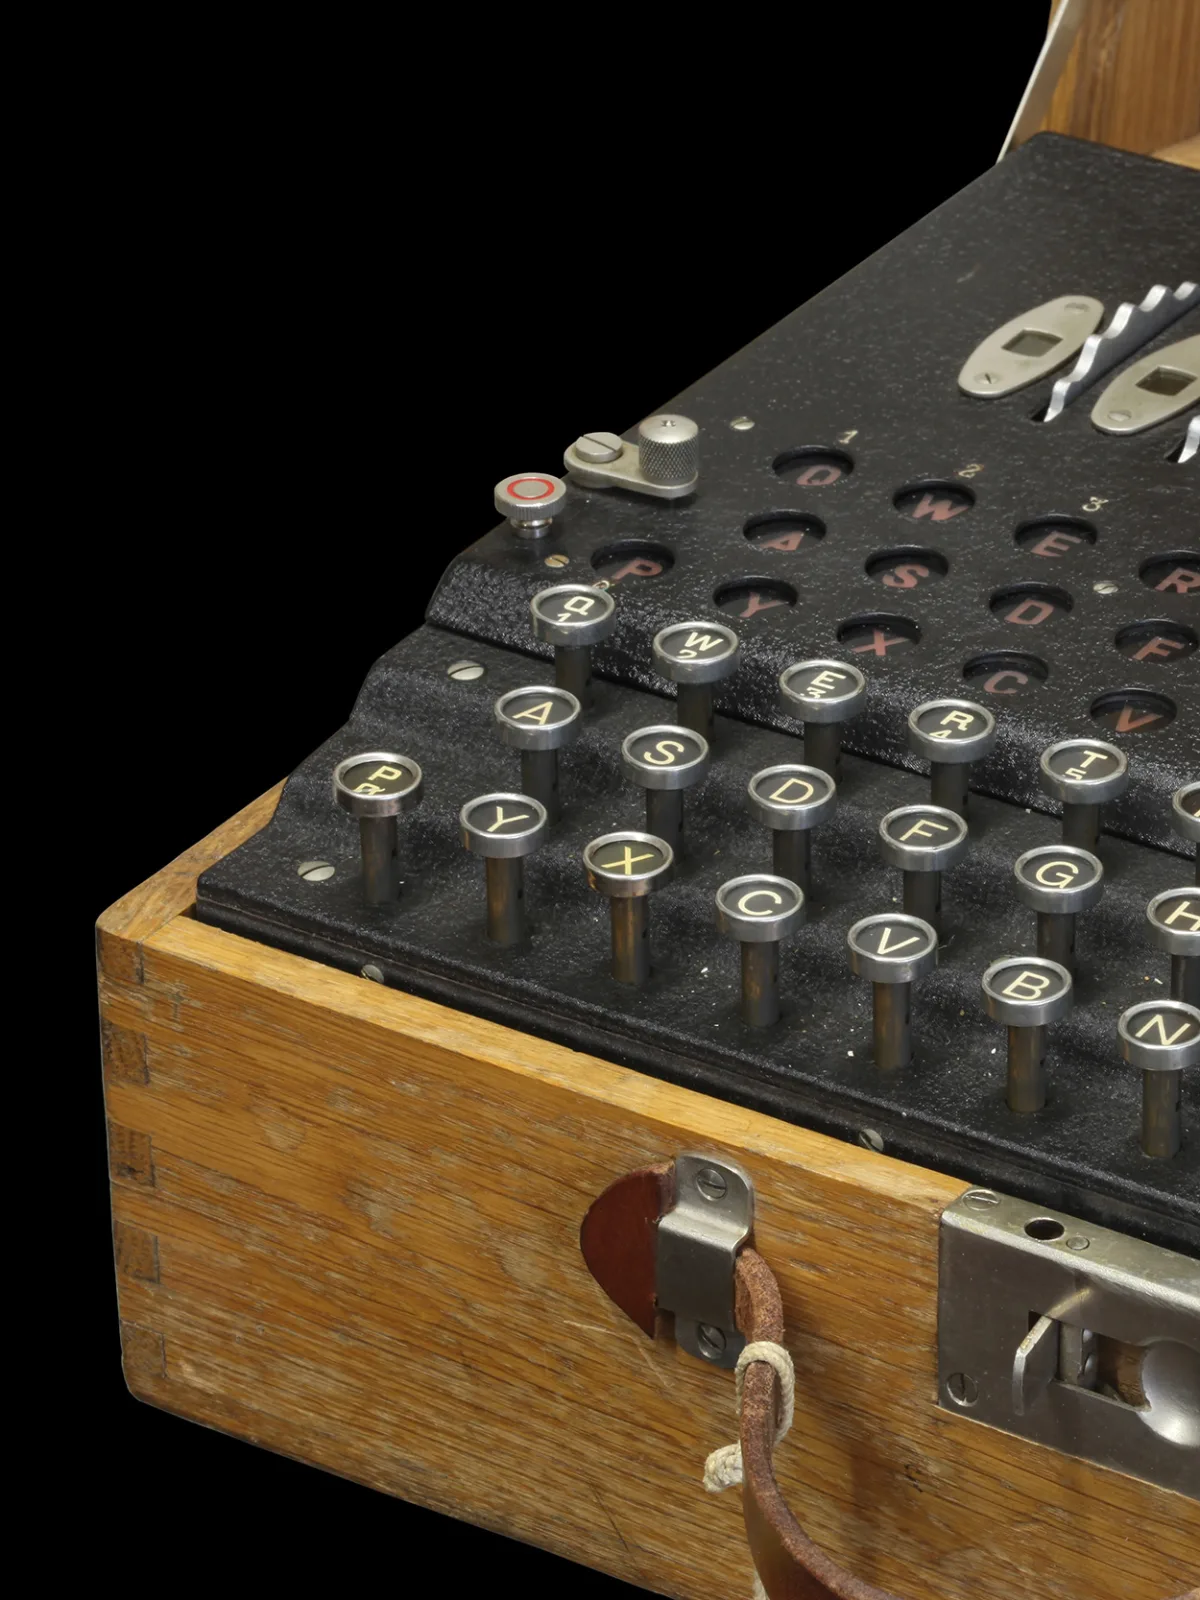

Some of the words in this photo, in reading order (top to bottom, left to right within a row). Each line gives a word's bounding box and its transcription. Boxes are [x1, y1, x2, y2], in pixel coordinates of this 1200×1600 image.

[838, 429, 858, 445] 1
[958, 463, 984, 479] 2
[912, 493, 969, 521] W
[1081, 496, 1109, 512] 3
[760, 530, 805, 552] A
[1030, 530, 1083, 558] E
[611, 557, 664, 581] P
[881, 564, 930, 589] S
[564, 596, 595, 616] Q
[739, 592, 787, 619] Y
[1003, 599, 1055, 625] D
[685, 631, 724, 652] W
[850, 630, 910, 657] X
[1132, 635, 1186, 662] F
[810, 670, 847, 690] E
[983, 670, 1030, 695] C
[511, 700, 554, 726] A
[940, 710, 975, 731] R
[1115, 705, 1165, 733] V
[643, 740, 685, 766] S
[1080, 750, 1108, 769] T
[367, 765, 402, 781] P
[768, 777, 815, 804] D
[486, 805, 530, 833] Y
[899, 819, 949, 842] F
[600, 845, 655, 877] X
[1036, 861, 1079, 889] G
[738, 890, 783, 917] C
[877, 927, 921, 955] V
[1001, 970, 1051, 1001] B
[1135, 1013, 1191, 1046] N
